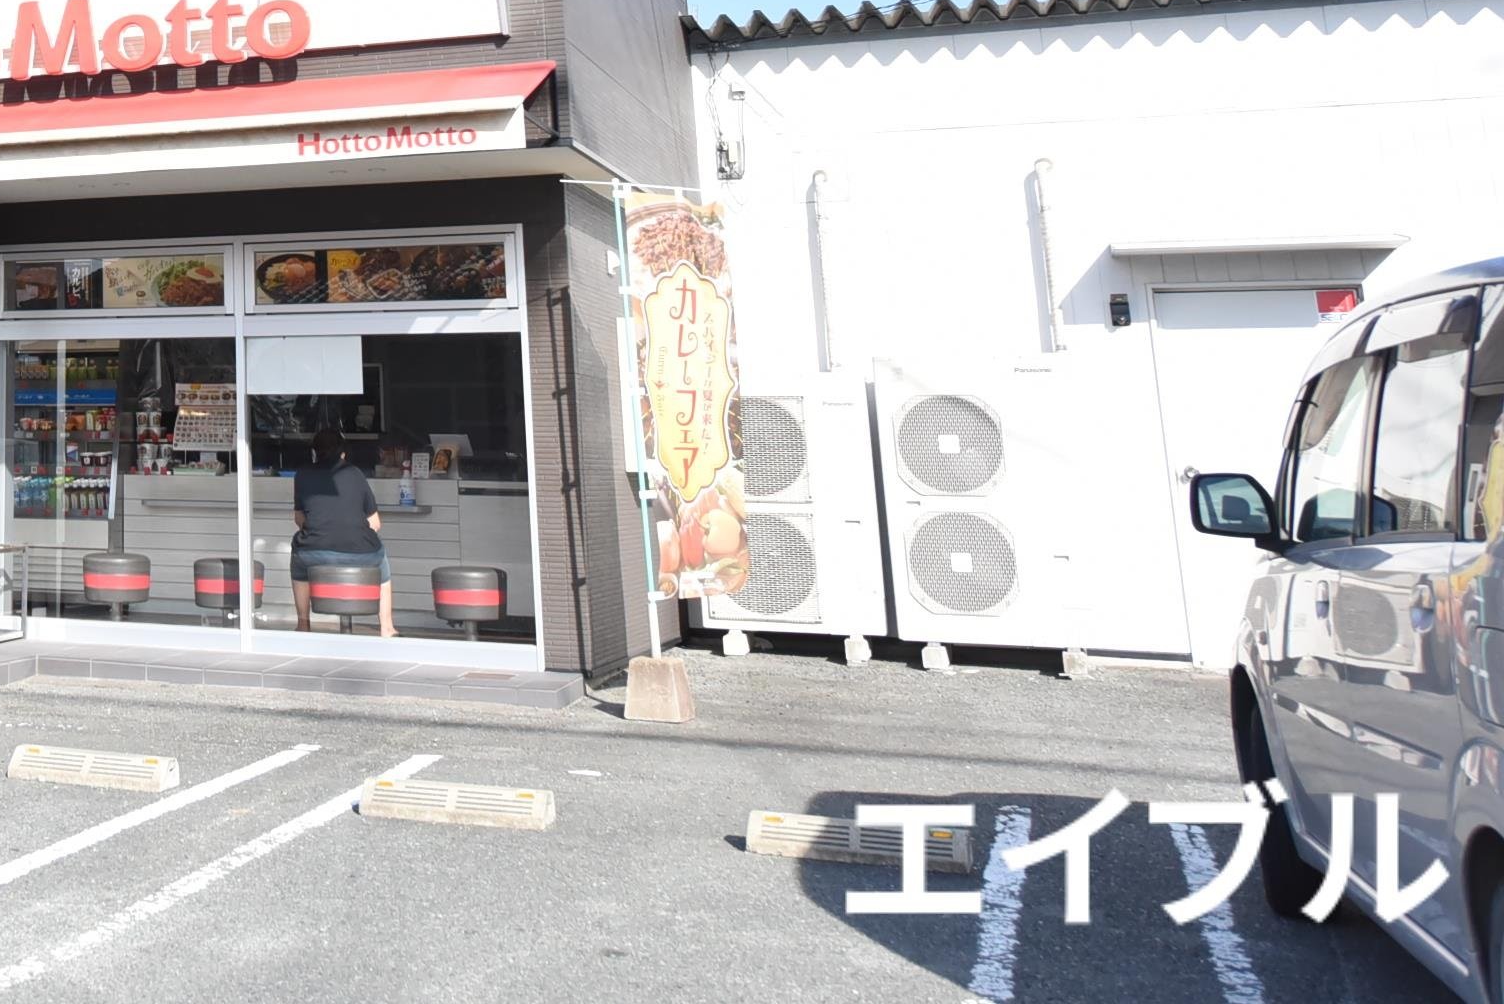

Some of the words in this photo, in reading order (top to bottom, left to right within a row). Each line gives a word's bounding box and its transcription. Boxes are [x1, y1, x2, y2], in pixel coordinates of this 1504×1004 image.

[669, 279, 699, 490] カレーフェア
